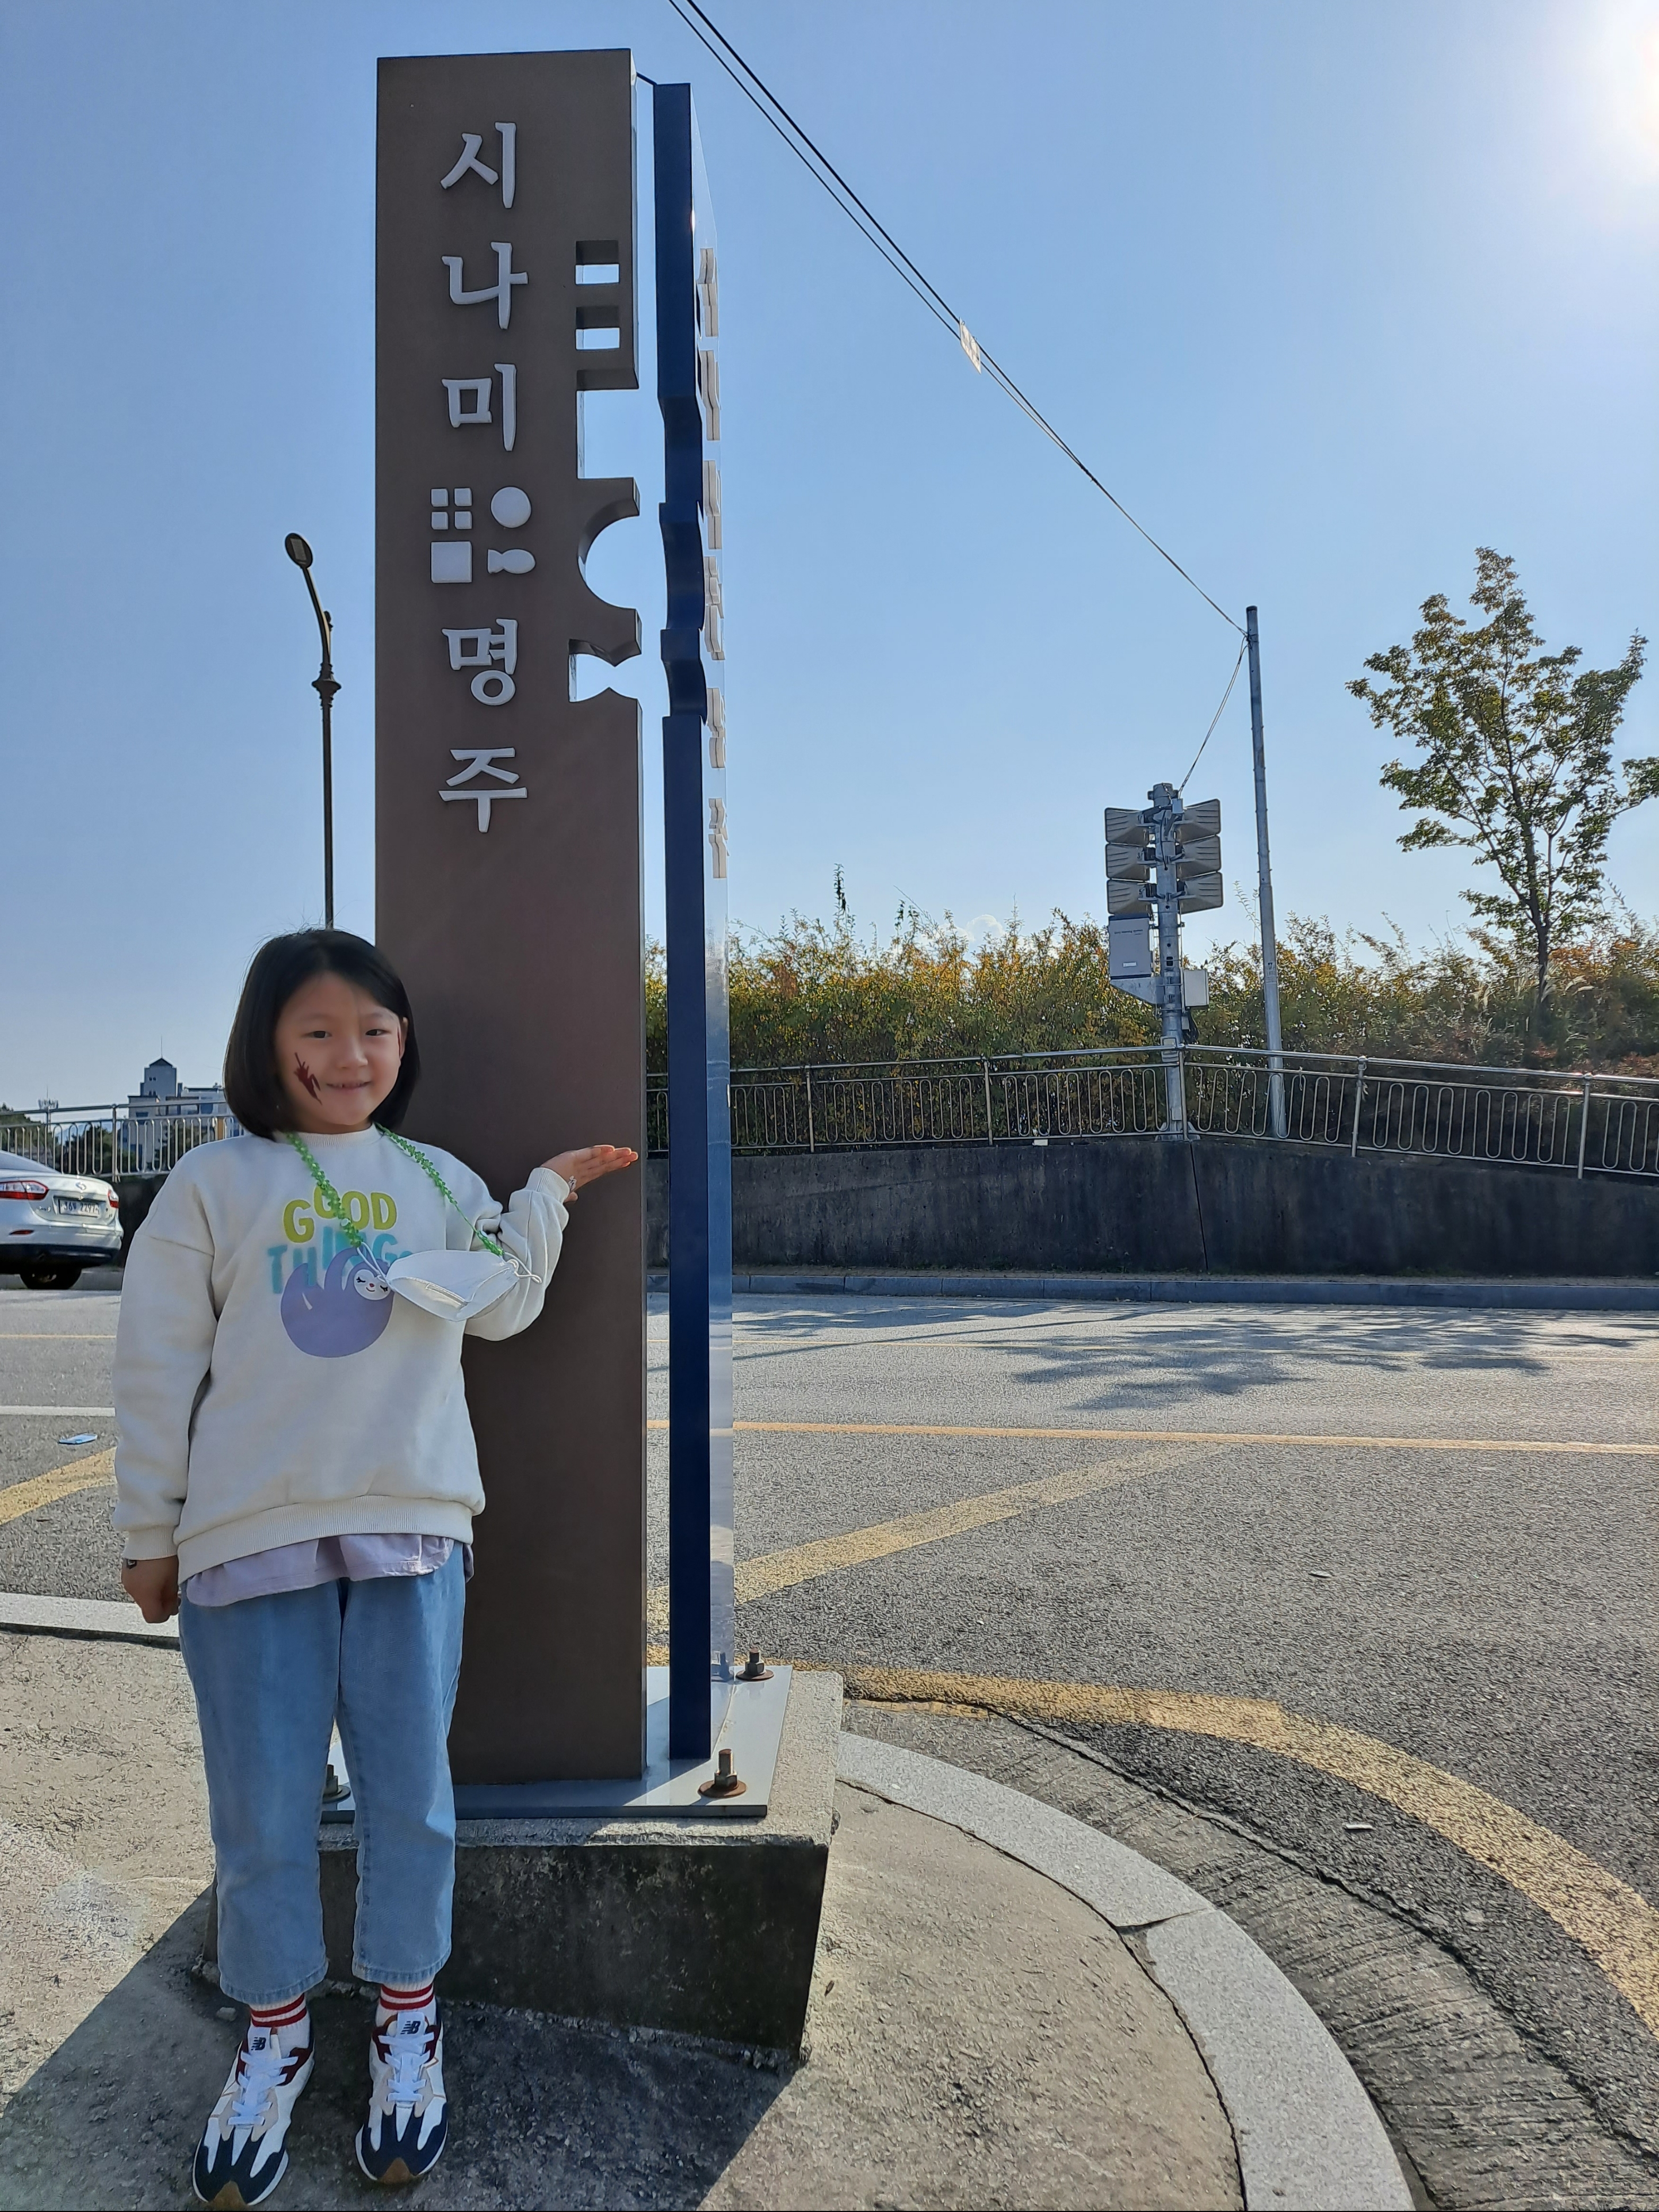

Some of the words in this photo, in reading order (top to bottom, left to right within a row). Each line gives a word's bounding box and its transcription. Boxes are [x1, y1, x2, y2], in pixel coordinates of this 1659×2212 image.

[440, 121, 529, 452] 시나미
[438, 618, 528, 833] 명주
[267, 1226, 414, 1294] THING
[283, 1185, 397, 1243] GOOD
